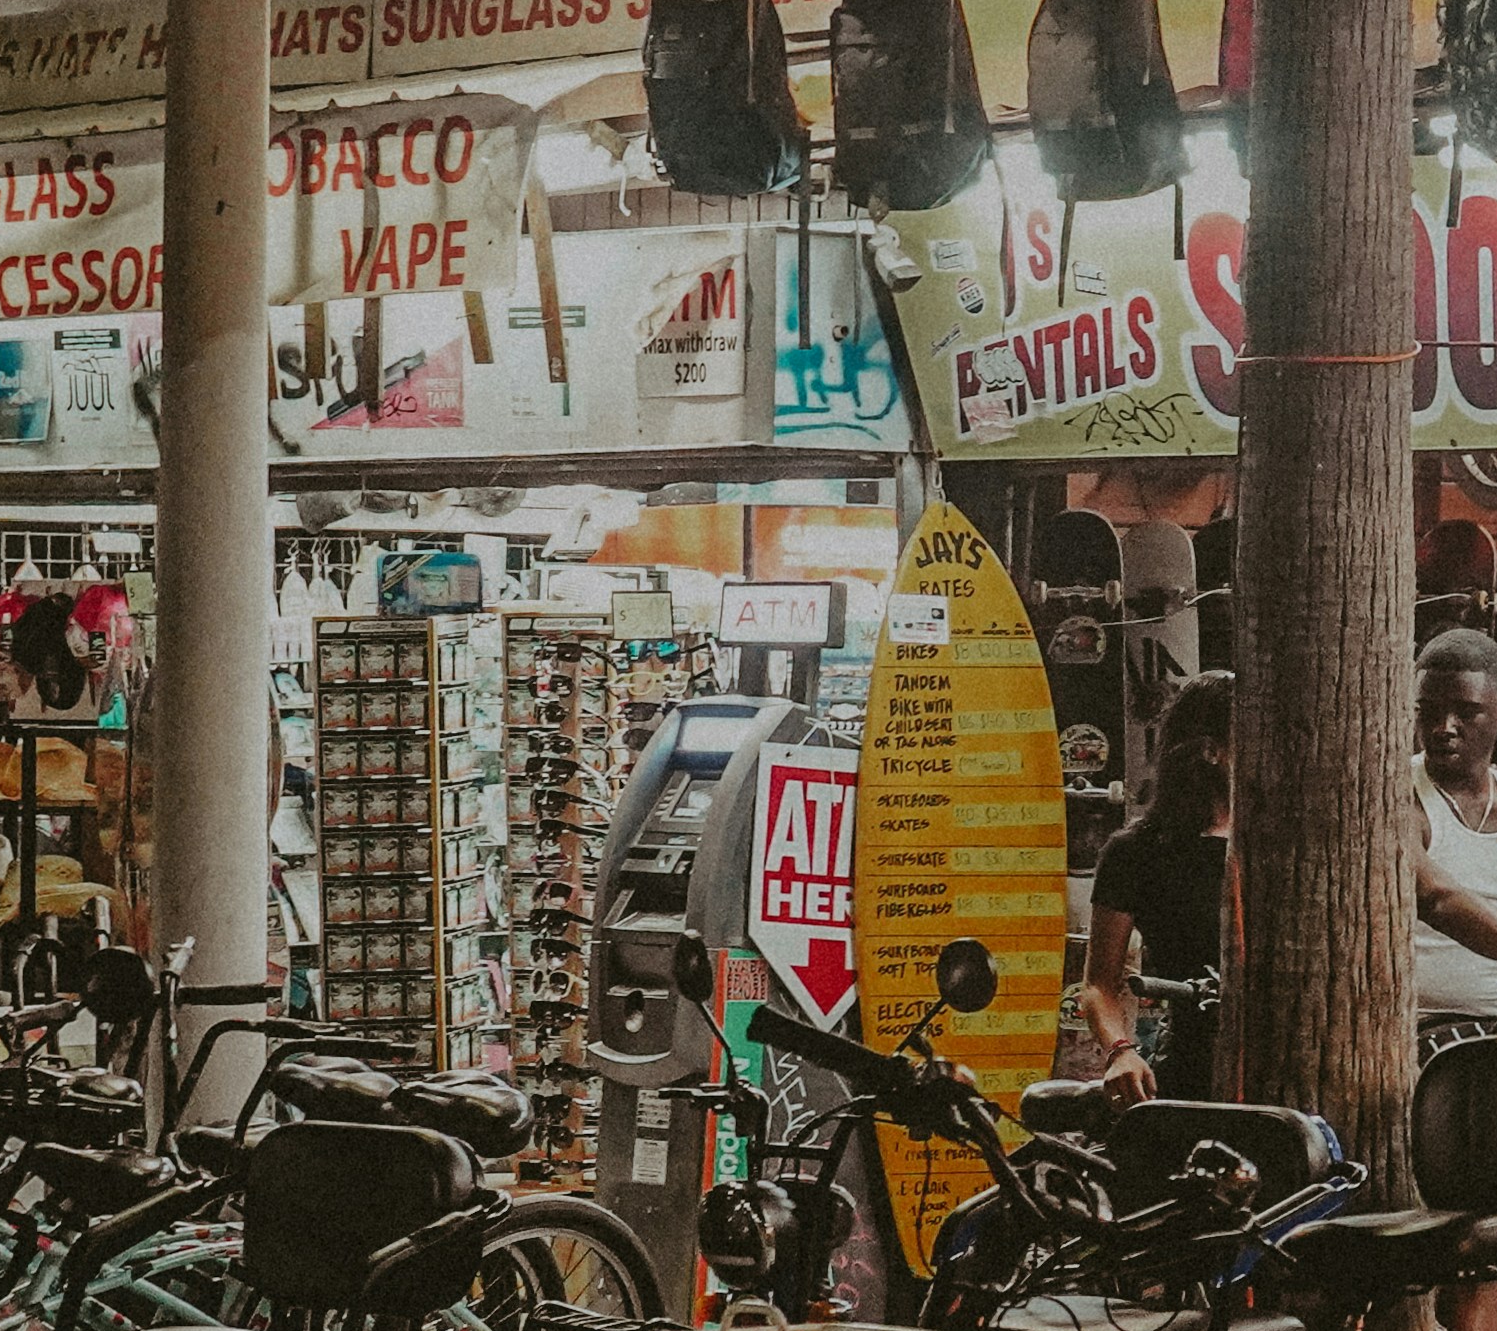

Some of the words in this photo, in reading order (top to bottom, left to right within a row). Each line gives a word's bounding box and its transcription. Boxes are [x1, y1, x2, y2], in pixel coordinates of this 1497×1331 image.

[267, 115, 474, 198] OBACCO
[340, 220, 468, 294] VAPE
[675, 331, 737, 353] withdraw
[675, 362, 707, 386] $200
[67, 373, 114, 411] JUUL
[915, 530, 987, 570] JAY'S
[919, 579, 975, 598] RATES
[737, 600, 816, 627] ATM
[896, 644, 939, 660] BIKES
[894, 674, 952, 691] TANDEM
[889, 698, 921, 716] BIKE
[924, 697, 953, 714] WITH
[874, 736, 891, 749] OR
[895, 736, 917, 750] TAG
[921, 734, 957, 748] ALONG
[881, 757, 953, 776] TRICYCLE
[877, 793, 951, 808] SKATEBOARDS
[879, 819, 930, 832] SKATES
[877, 852, 947, 867] SURFSKATE
[766, 878, 854, 922] HER
[877, 883, 947, 898] SURFBOARD
[876, 902, 952, 919] FIBERGLASS
[877, 945, 946, 960] SURFBOAR
[878, 962, 907, 978] SOFT
